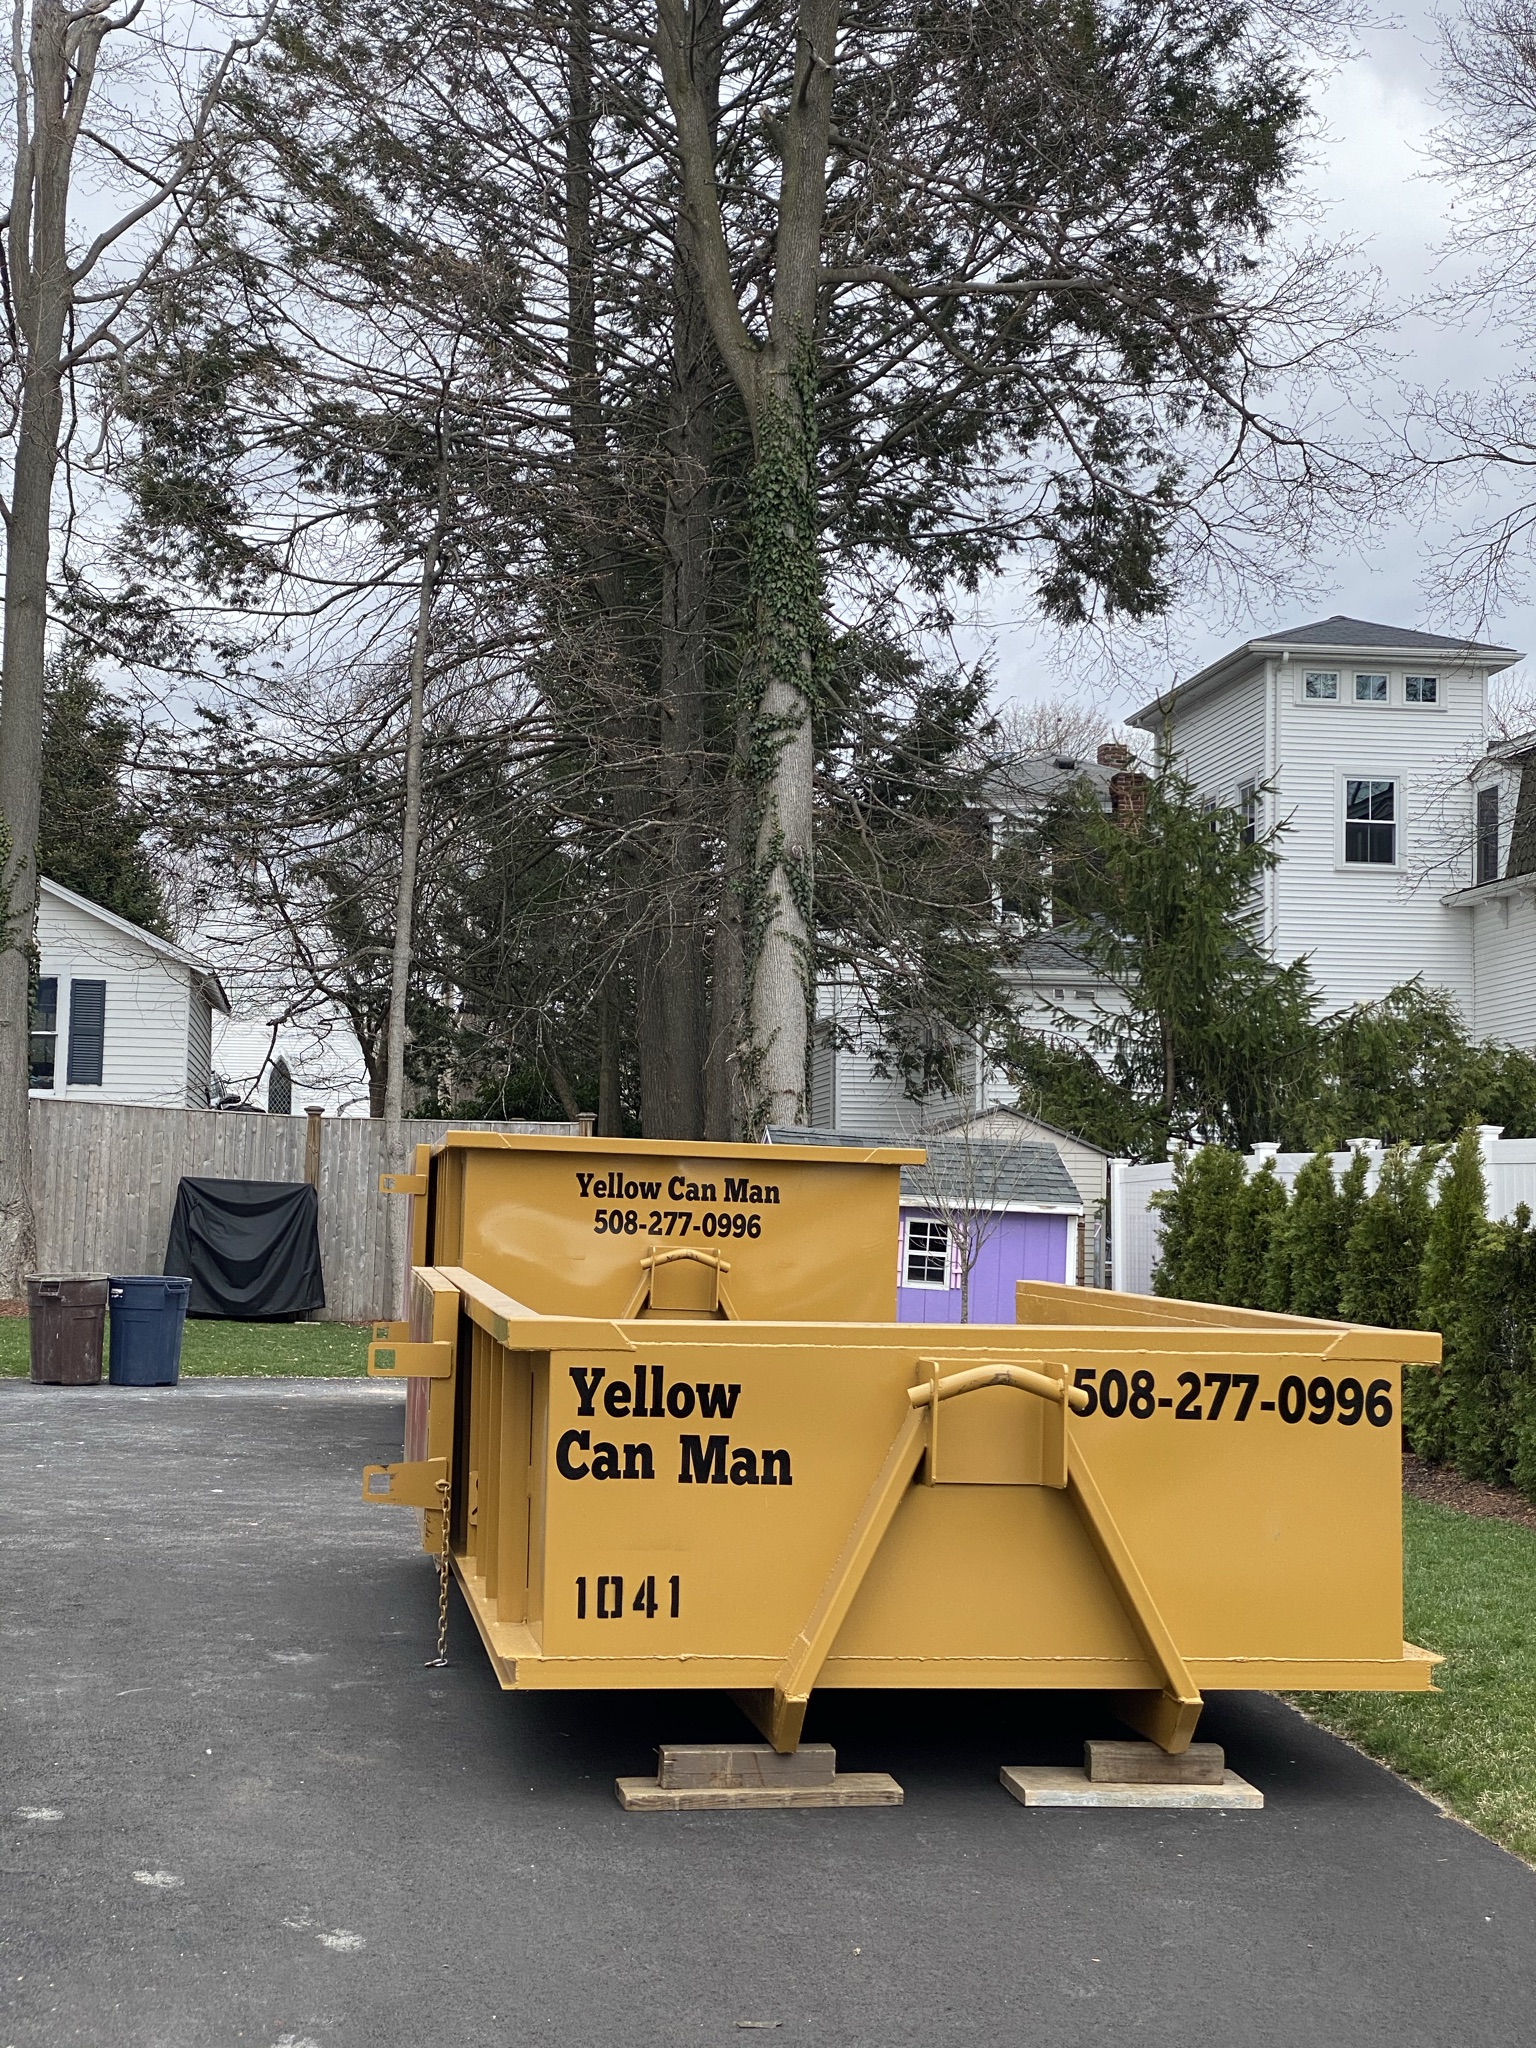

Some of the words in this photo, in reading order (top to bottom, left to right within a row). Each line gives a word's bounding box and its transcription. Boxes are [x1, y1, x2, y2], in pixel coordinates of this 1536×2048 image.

[575, 1171, 663, 1200] Yellow
[668, 1175, 717, 1202] Can
[723, 1177, 781, 1204] Man
[593, 1209, 762, 1239] 508-277-0996
[568, 1364, 742, 1419] Yellow
[1070, 1368, 1393, 1428] 508-277-0996
[555, 1429, 655, 1481] Can
[677, 1434, 793, 1486] Man
[575, 1575, 680, 1619] 1041
